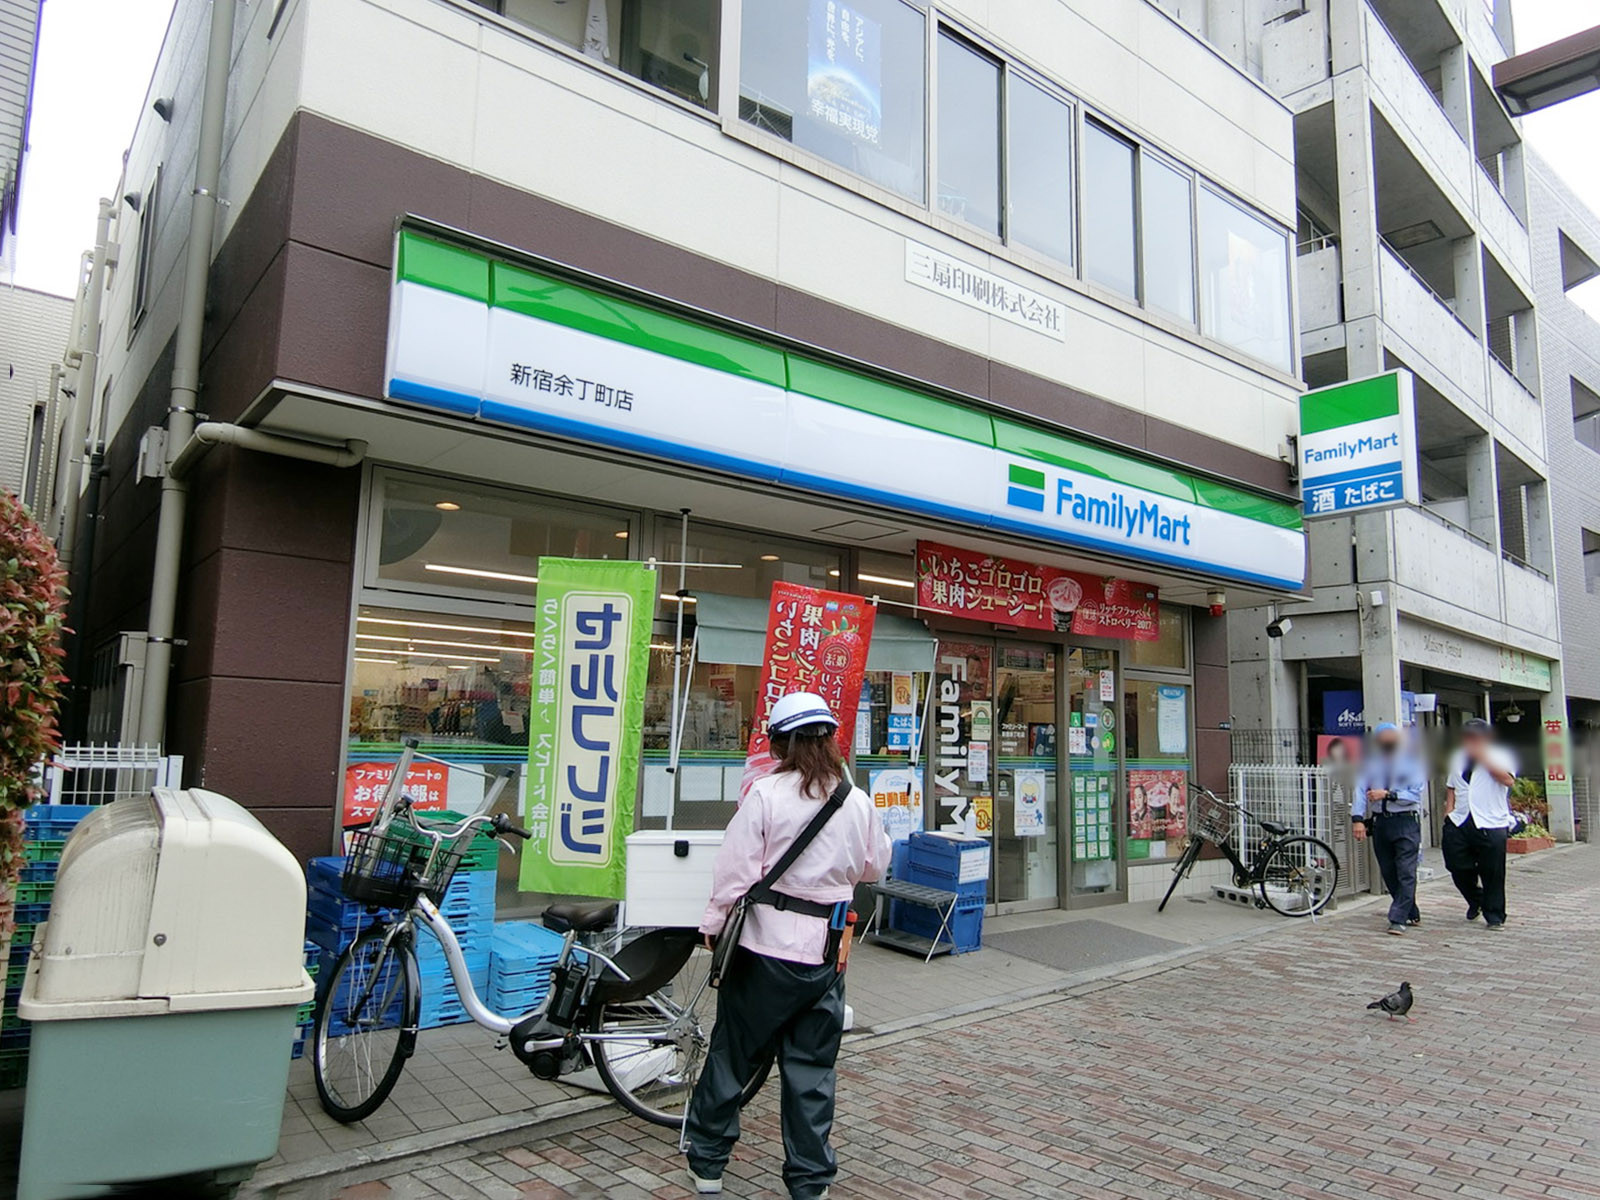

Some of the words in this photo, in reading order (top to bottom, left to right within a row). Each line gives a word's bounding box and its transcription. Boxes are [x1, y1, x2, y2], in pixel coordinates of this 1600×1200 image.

[811, 99, 879, 144] 幸福実現党
[911, 250, 1061, 332] 三扇印刷株式会社
[510, 362, 634, 412] 新宿余丁町店
[1304, 432, 1399, 464] FamilyMart
[1056, 478, 1190, 546] FamilyMart
[1312, 487, 1336, 512] 酒
[1344, 480, 1395, 505] たばこ
[355, 768, 442, 781] ファミリマートの
